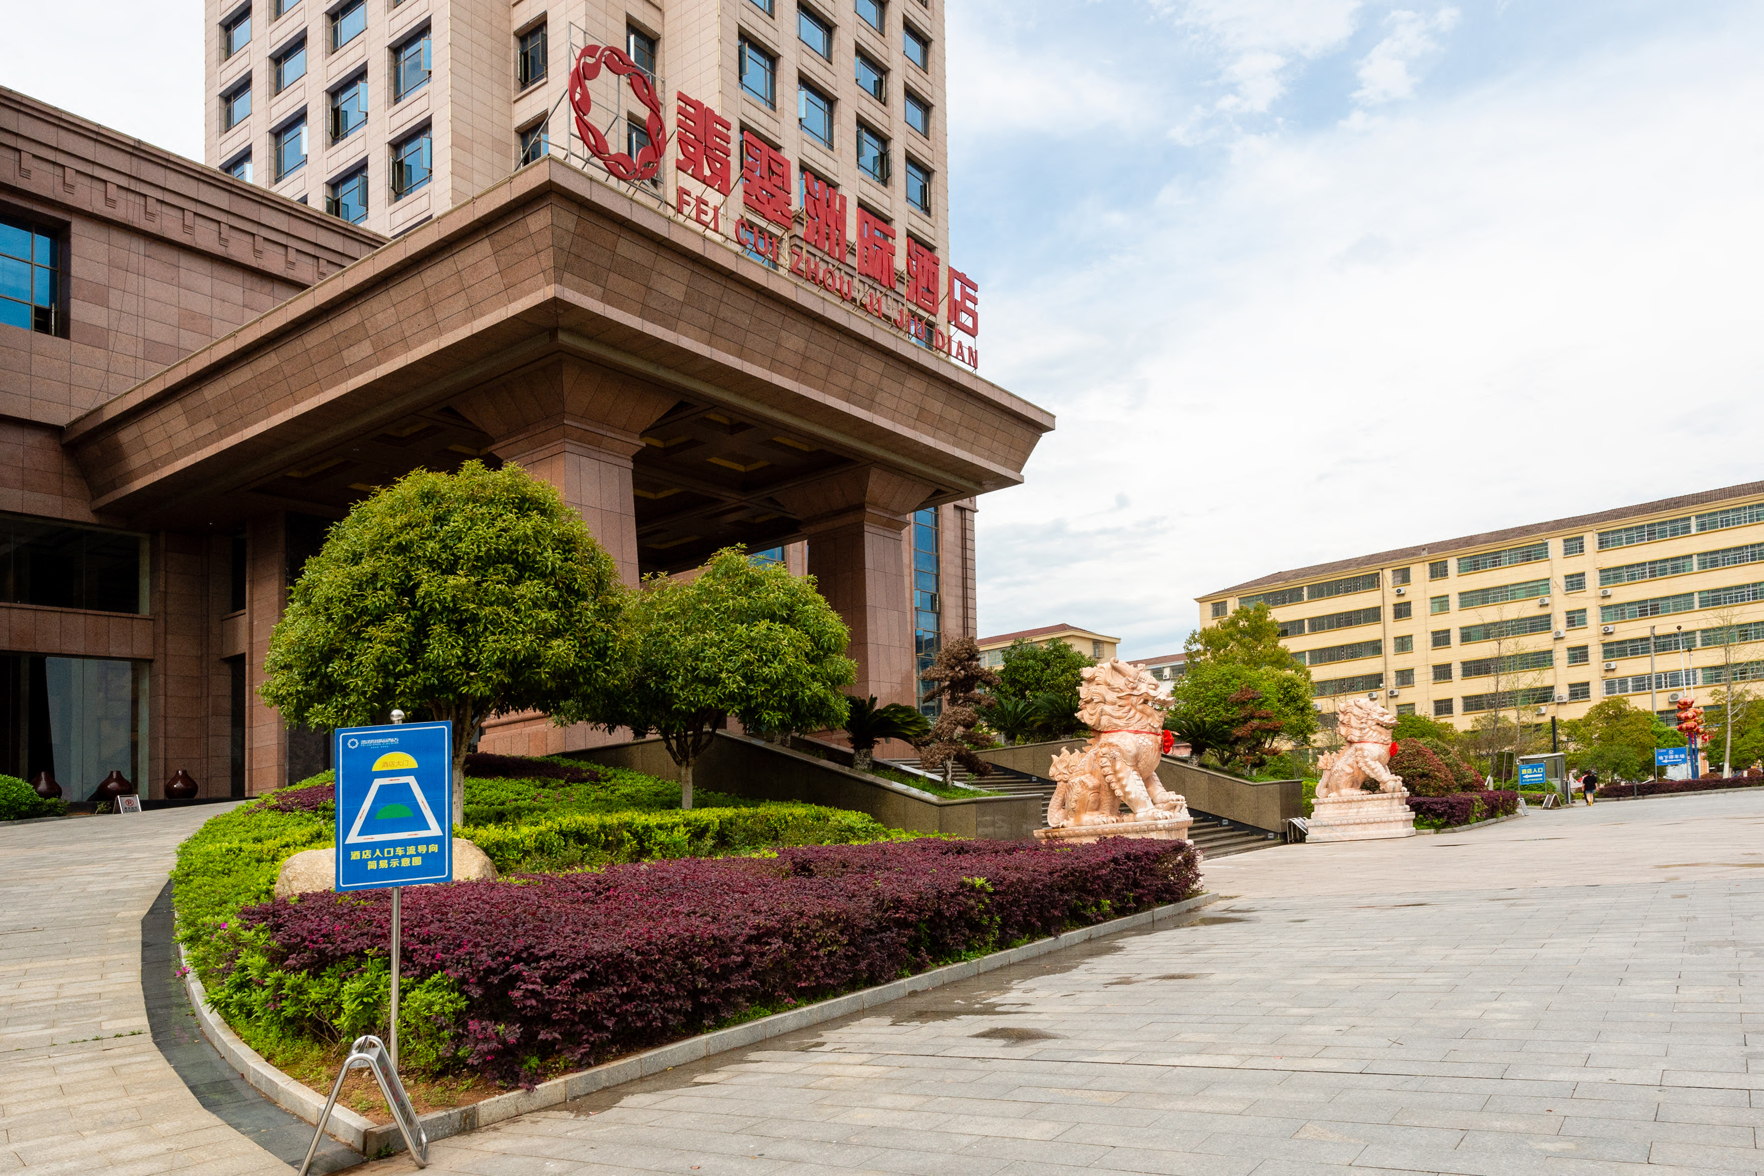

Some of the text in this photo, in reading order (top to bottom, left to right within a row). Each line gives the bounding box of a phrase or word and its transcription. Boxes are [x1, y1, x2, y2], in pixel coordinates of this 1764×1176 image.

[676, 90, 978, 338] 翡翠洲际酒店
[677, 185, 978, 370] FEI CUI ZHOU JI JIU DIAN
[382, 760, 409, 768] 酒店大门
[350, 844, 438, 860] 酒店入口车流导向
[367, 856, 422, 870] 简易示意图
